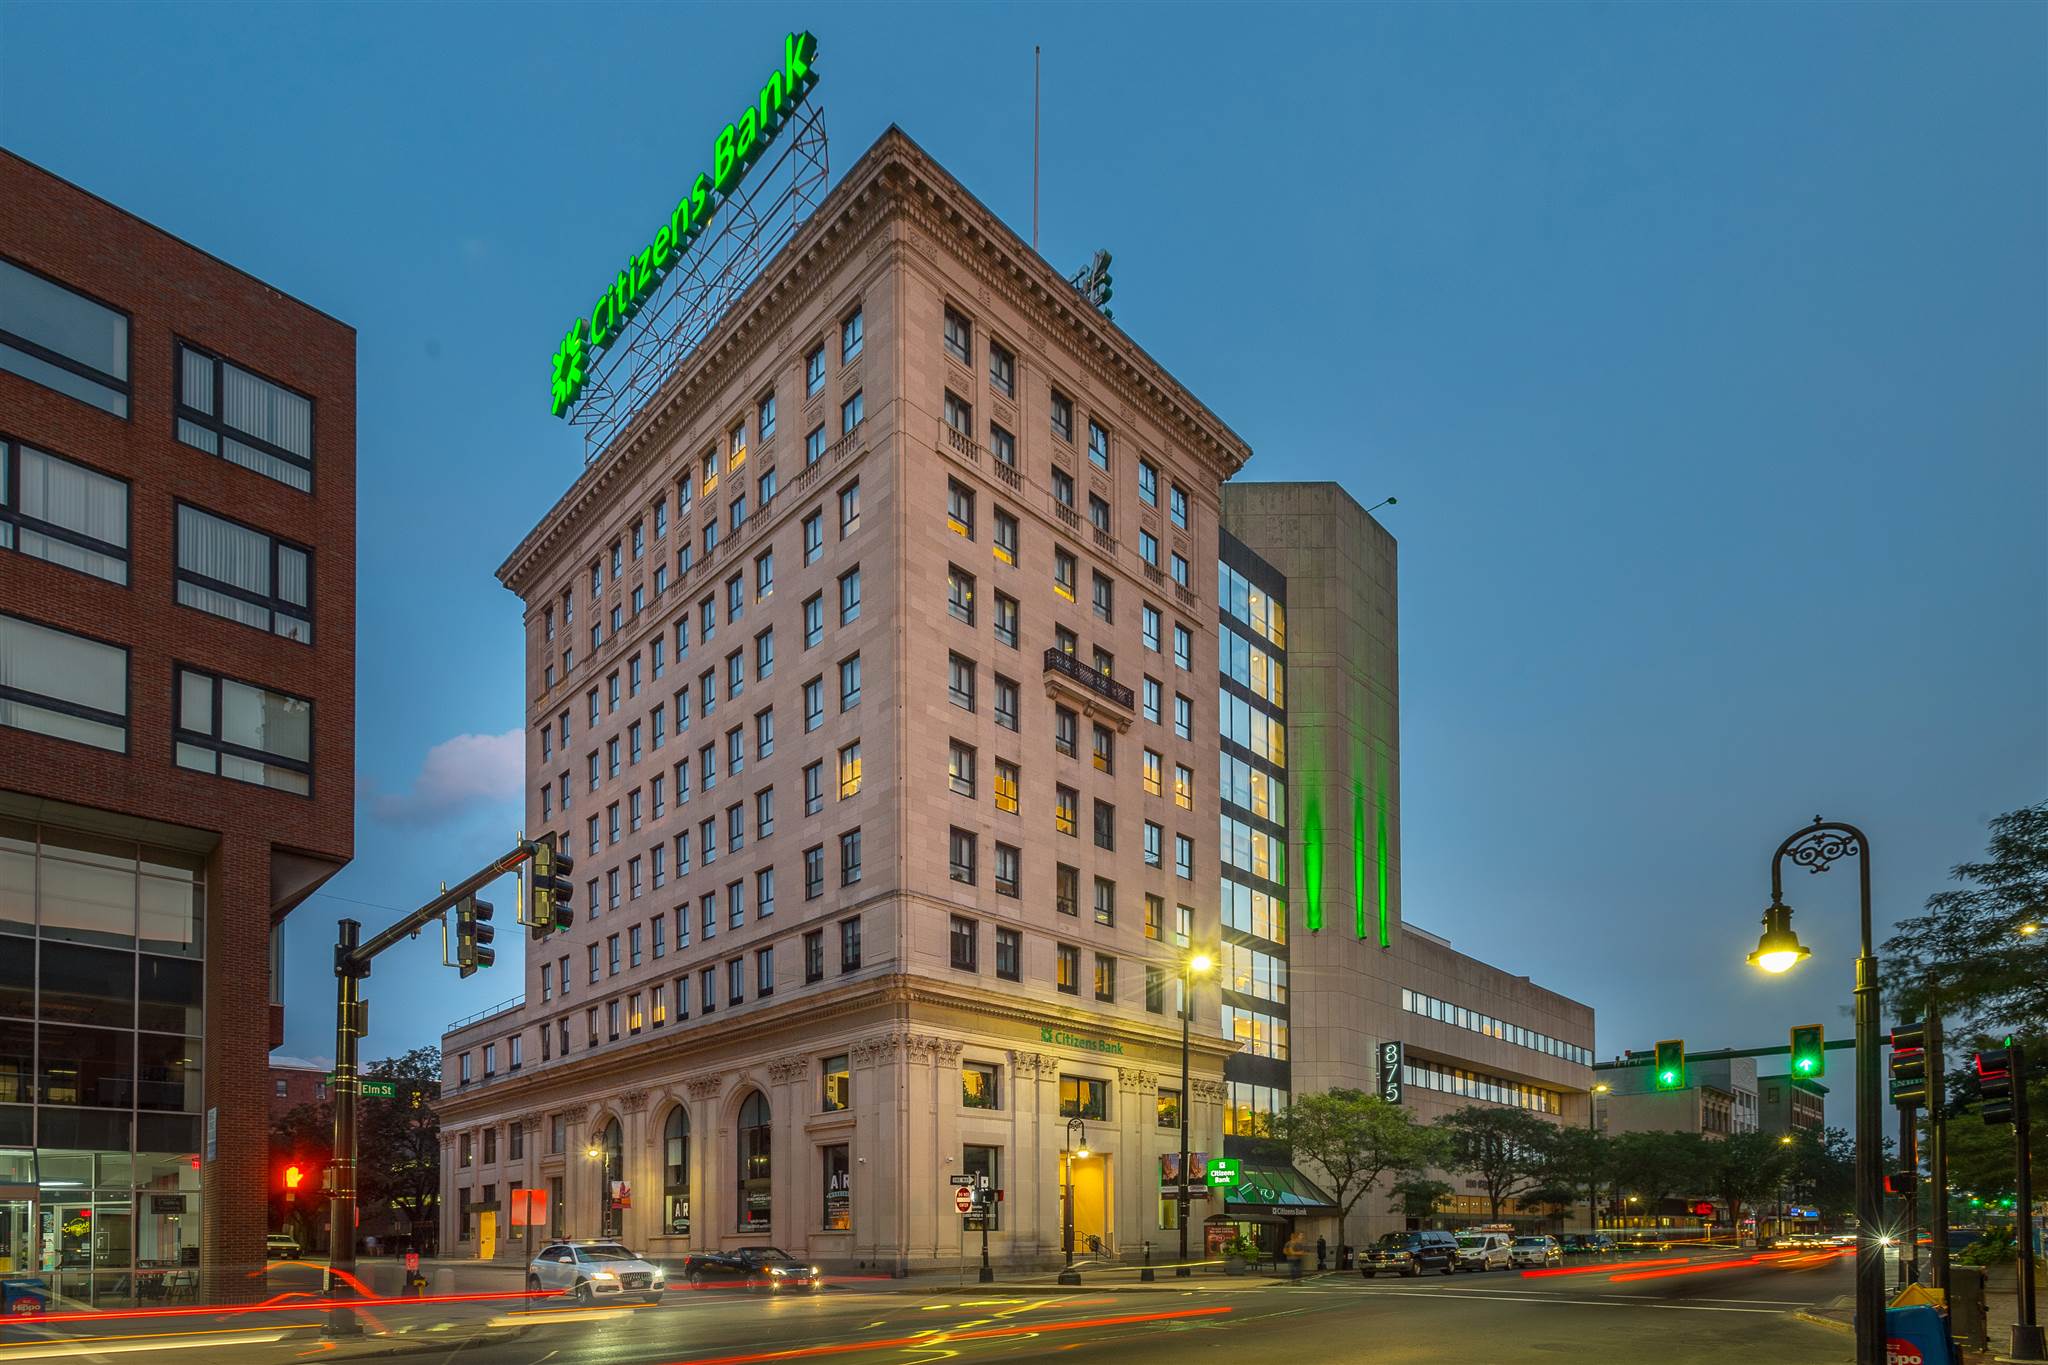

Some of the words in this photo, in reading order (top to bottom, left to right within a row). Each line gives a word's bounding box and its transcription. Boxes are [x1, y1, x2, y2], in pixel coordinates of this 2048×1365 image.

[590, 171, 715, 349] Citizens
[714, 31, 817, 194] Bank
[1055, 1031, 1097, 1050] Citizens
[1099, 1039, 1124, 1055] Bank
[1385, 1044, 1398, 1102] 875
[362, 1084, 380, 1094] Elm
[381, 1085, 391, 1095] St
[1277, 1207, 1295, 1215] Citizens
[1296, 1207, 1307, 1216] Bank
